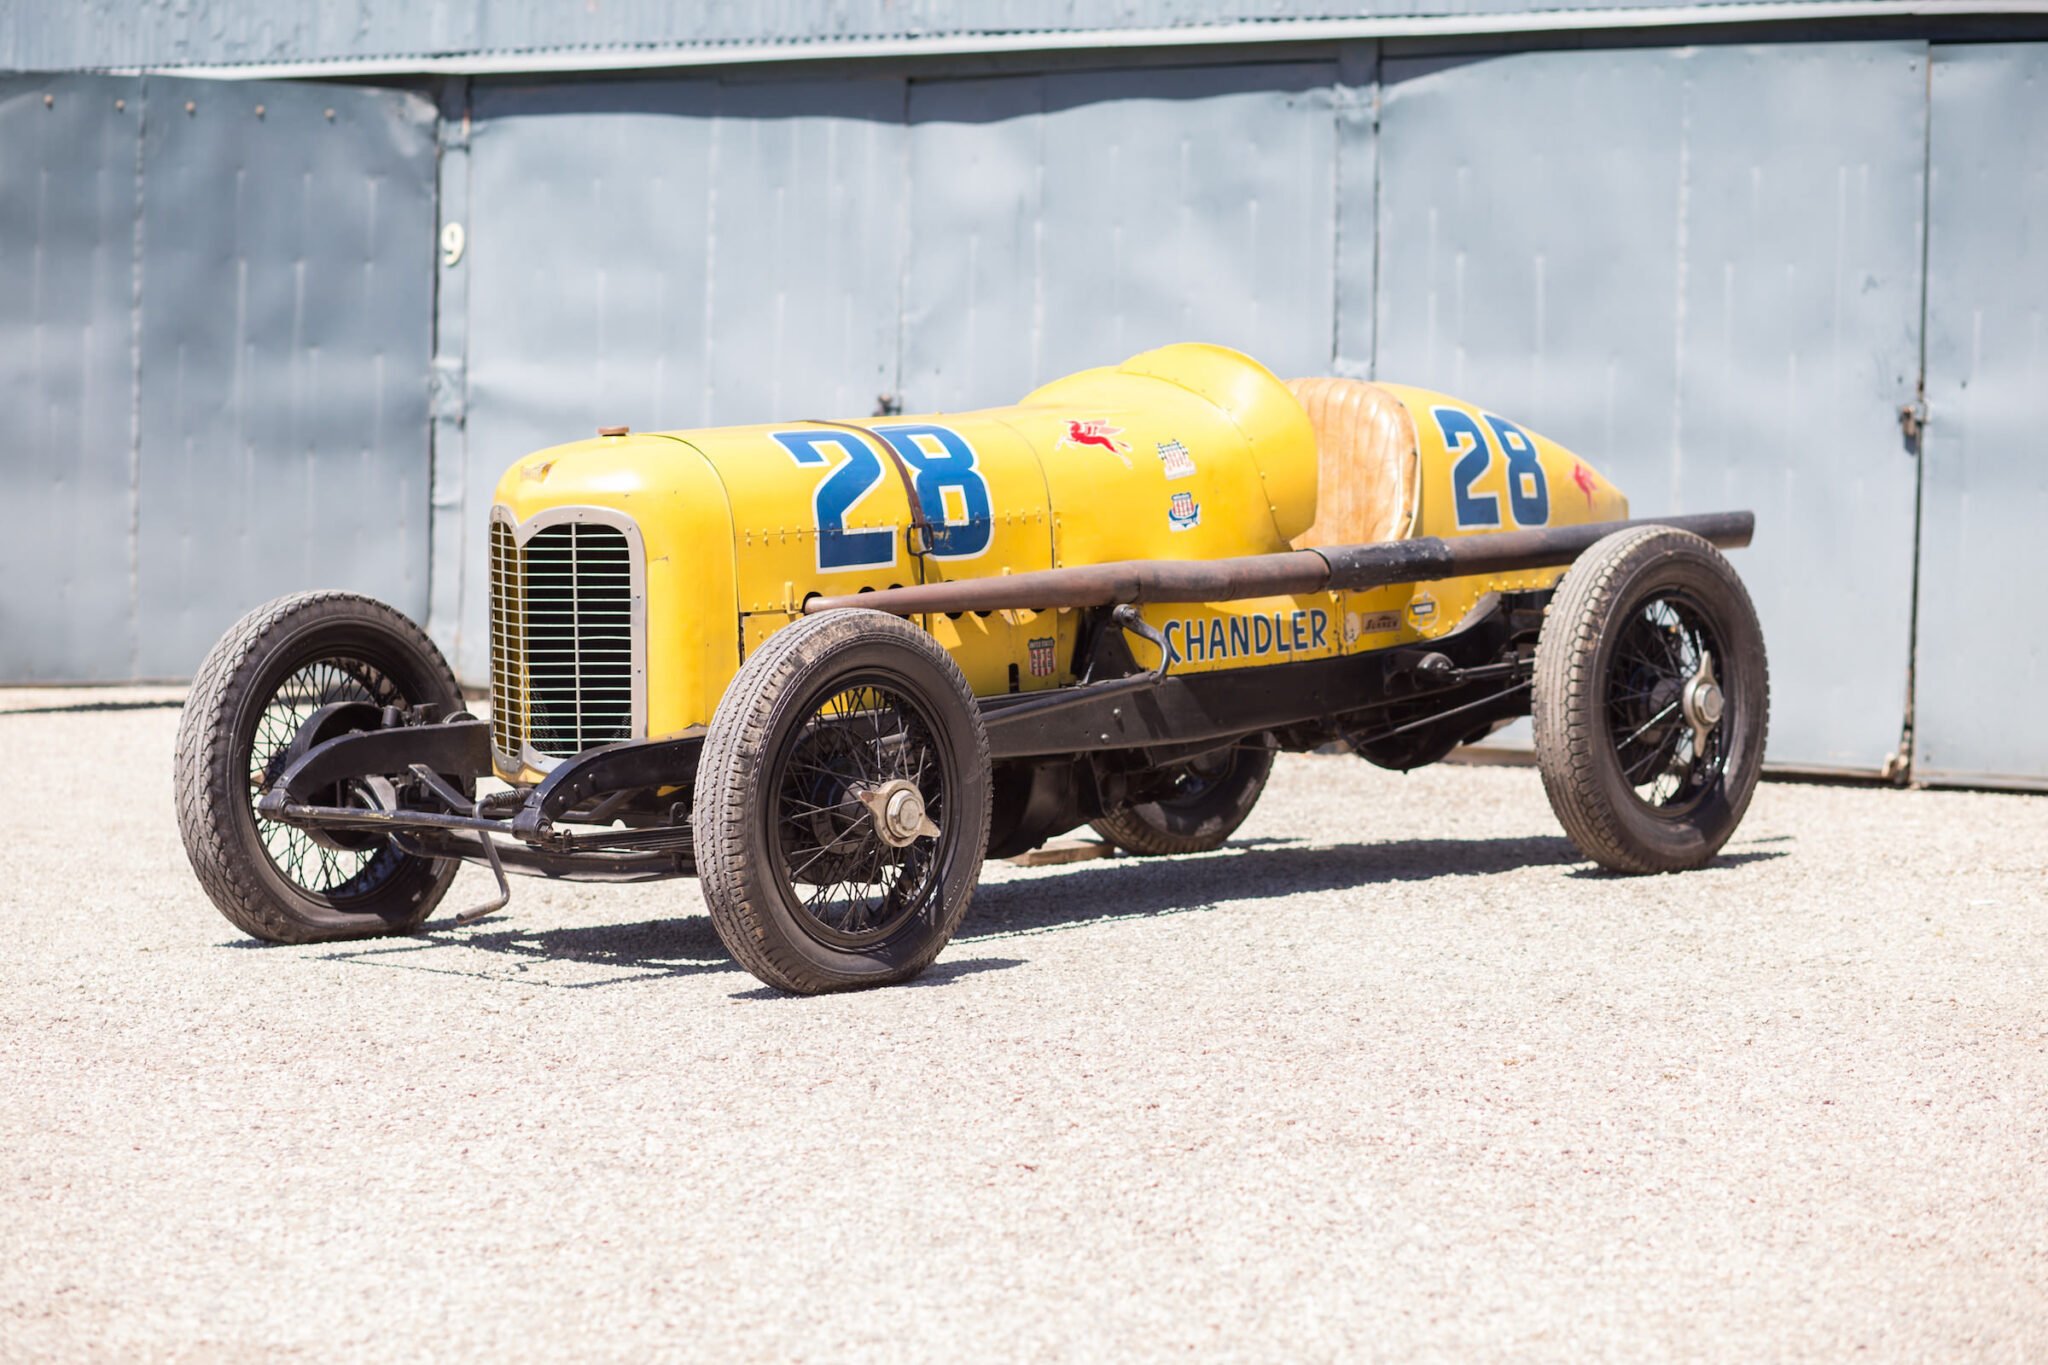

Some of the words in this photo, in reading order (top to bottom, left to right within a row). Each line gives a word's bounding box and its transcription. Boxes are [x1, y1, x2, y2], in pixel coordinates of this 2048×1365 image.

[441, 222, 465, 267] 9
[768, 424, 994, 574] 28
[1431, 405, 1549, 531] 28
[1163, 608, 1328, 664] CHANDLER
